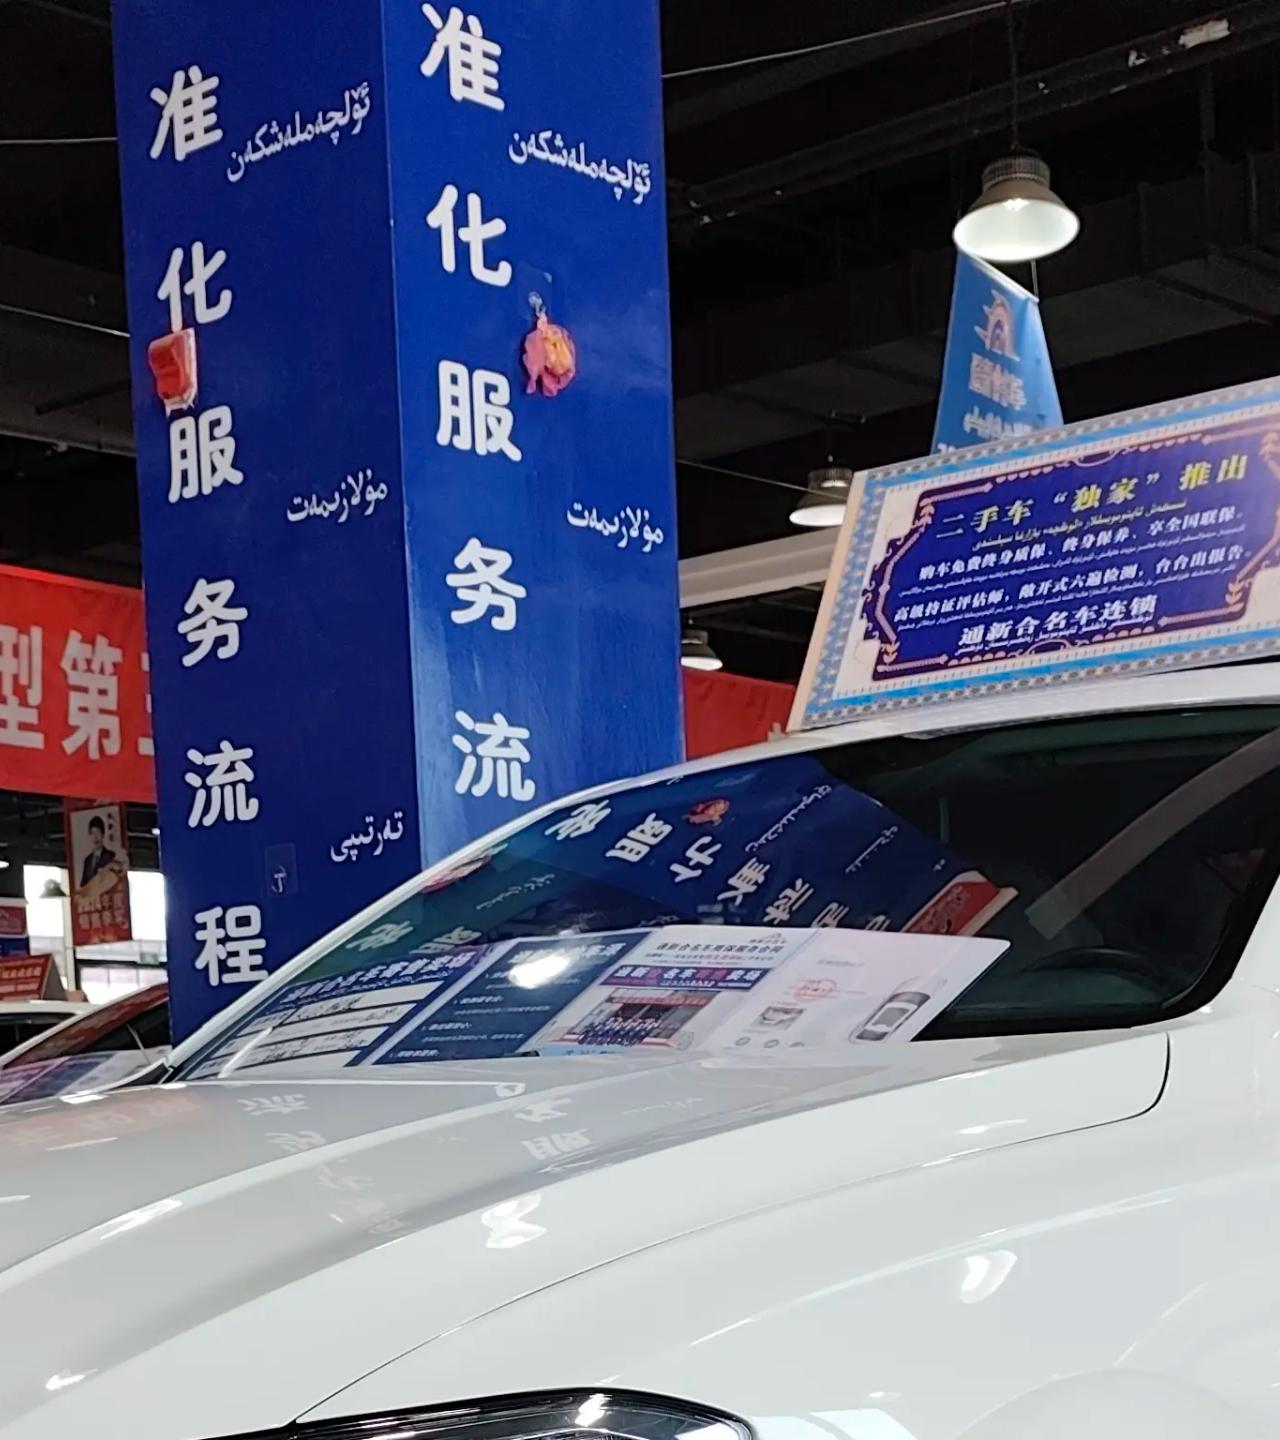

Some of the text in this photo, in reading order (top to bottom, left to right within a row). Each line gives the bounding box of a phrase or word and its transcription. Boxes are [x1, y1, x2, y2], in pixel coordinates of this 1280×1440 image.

[150, 65, 270, 987] 准化服务流程
[936, 499, 1035, 539] 二手车
[1179, 454, 1249, 491] 推出
